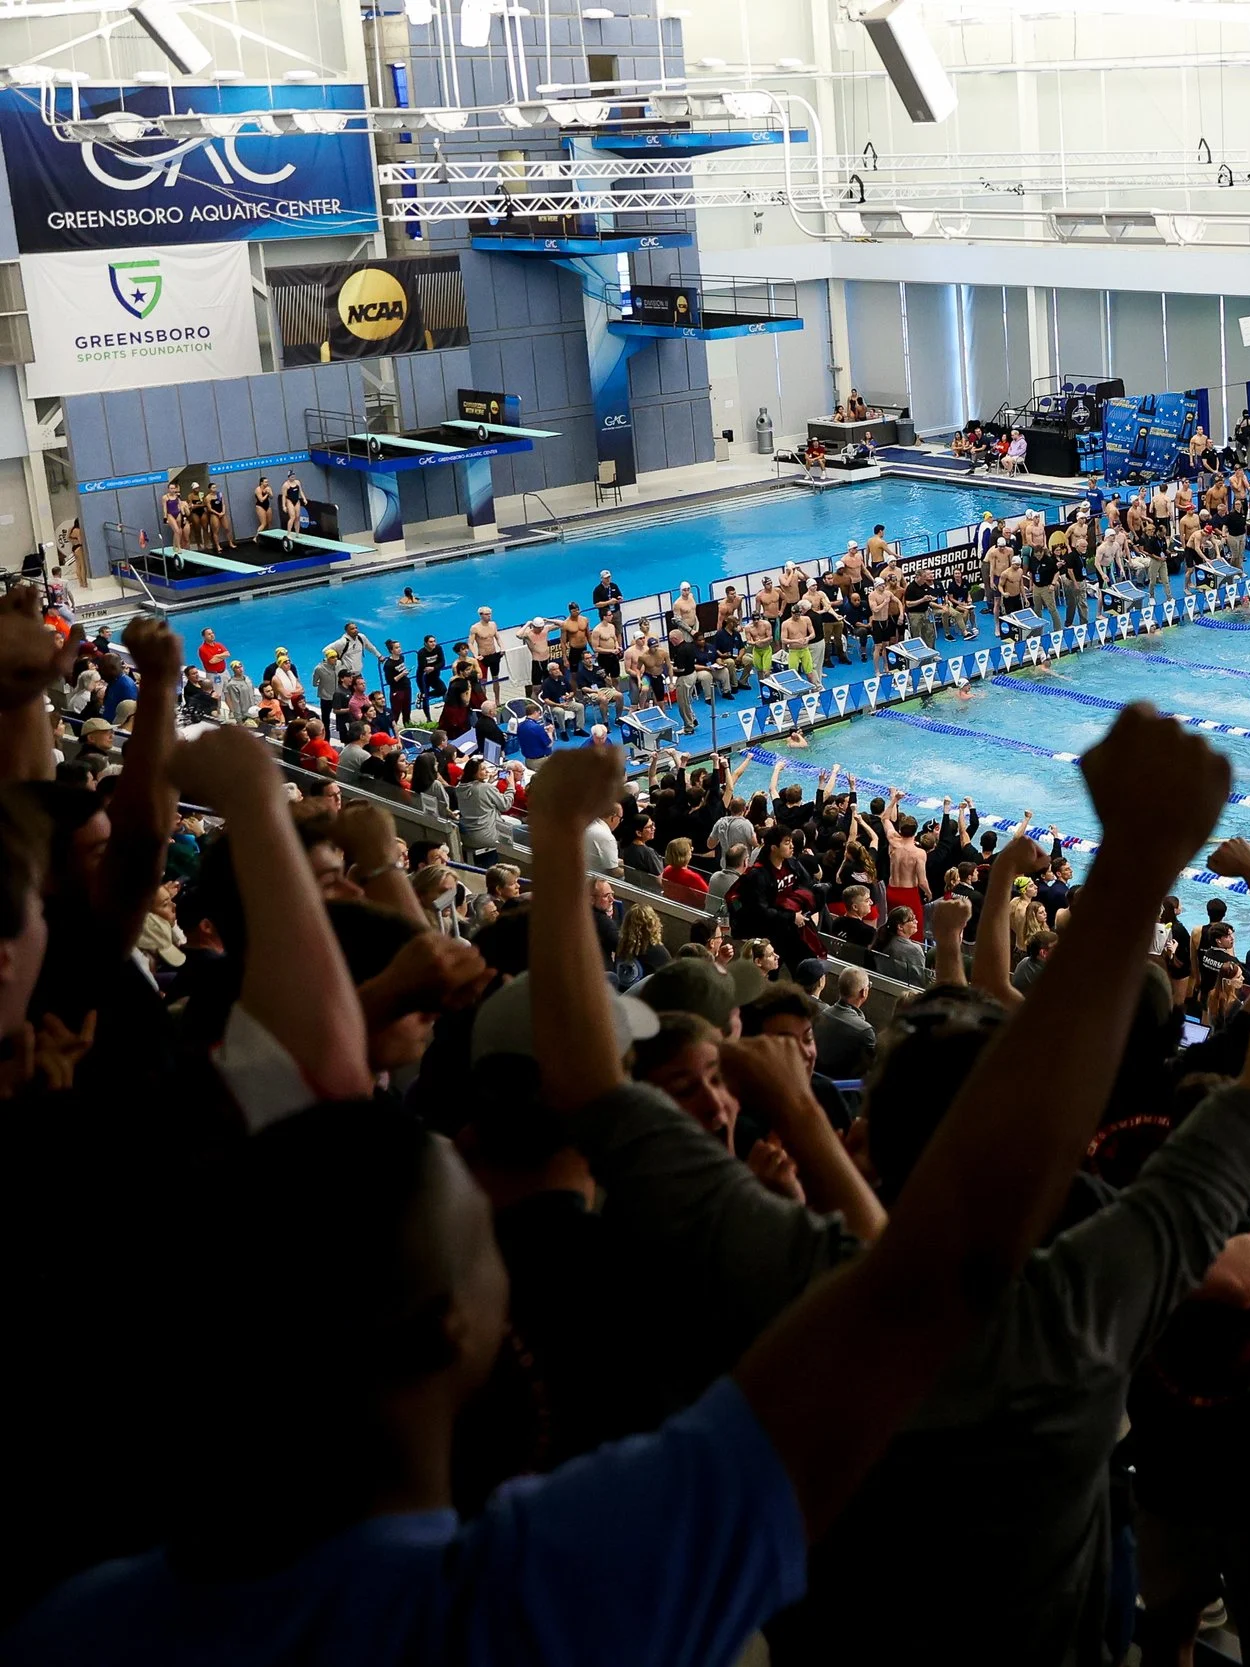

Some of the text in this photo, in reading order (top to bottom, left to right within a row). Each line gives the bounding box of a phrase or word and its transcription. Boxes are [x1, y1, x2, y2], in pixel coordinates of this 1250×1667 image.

[47, 198, 342, 230] GREENSBORO AQUATIC CENTER
[347, 301, 405, 326] NCAA
[75, 325, 212, 350] GREENSBORO
[77, 342, 213, 363] SPORTS FOUNDATION
[605, 414, 627, 426] GAC
[419, 455, 436, 466] GAC
[902, 548, 968, 574] GREENSBORO
[1203, 955, 1224, 969] EMORY
